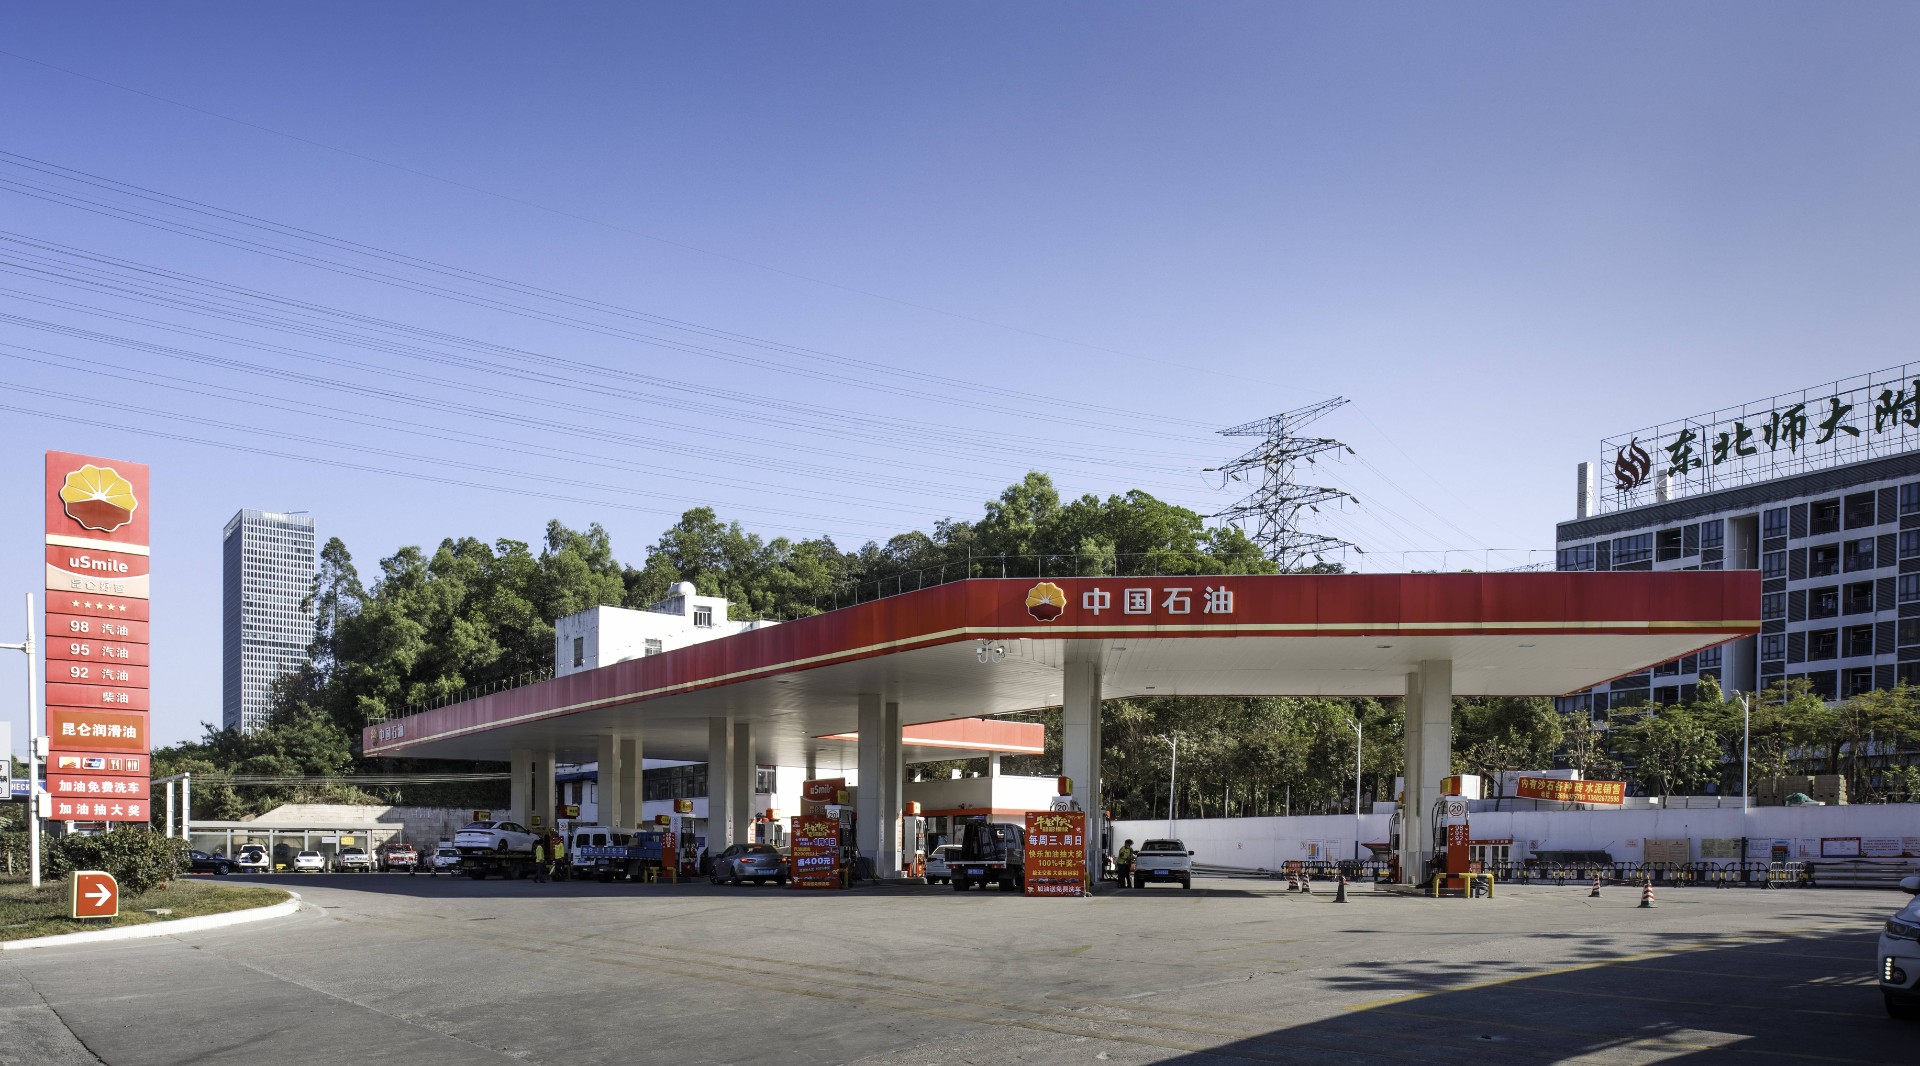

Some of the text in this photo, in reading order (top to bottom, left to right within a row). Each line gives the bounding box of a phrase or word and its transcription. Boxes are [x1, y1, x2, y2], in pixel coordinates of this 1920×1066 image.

[69, 555, 129, 573] uSmile
[1082, 585, 1234, 615] 中国石油
[70, 620, 129, 636] 98 汽油
[70, 643, 129, 659] 95 汽油
[70, 666, 129, 682] 92 汽油
[102, 691, 129, 704] 柴油
[62, 722, 137, 739] 昆仑润滑油
[59, 780, 140, 794] 加油免费洗车
[59, 803, 140, 817] 加油抽大奖
[1028, 835, 1082, 846] 每周三、周日
[1028, 850, 1083, 858] 快乐加油抽大奖
[1038, 859, 1073, 867] 100%中奖
